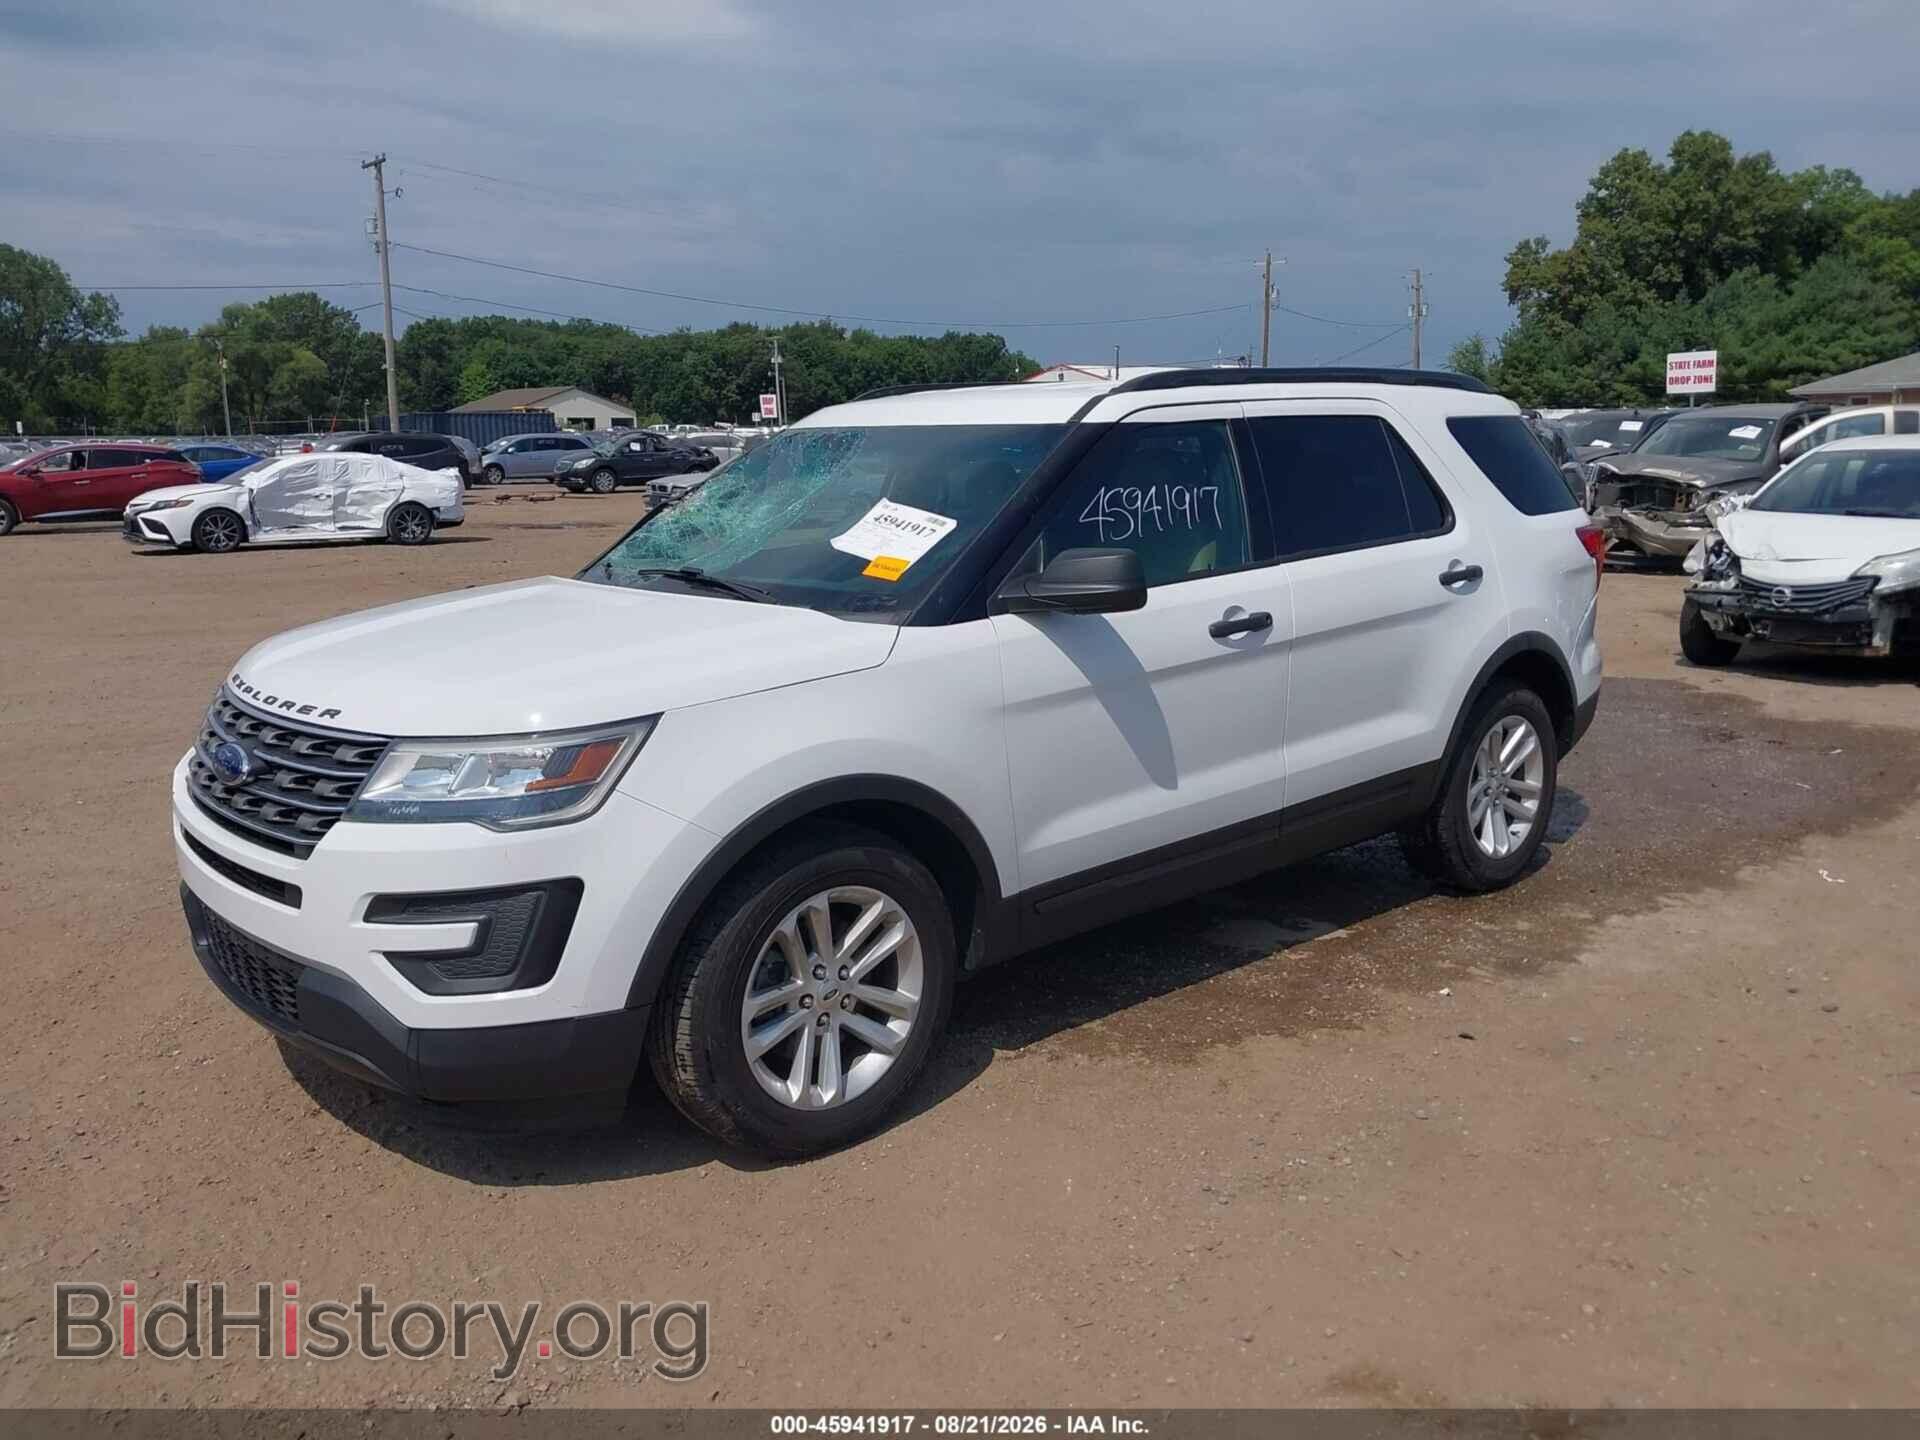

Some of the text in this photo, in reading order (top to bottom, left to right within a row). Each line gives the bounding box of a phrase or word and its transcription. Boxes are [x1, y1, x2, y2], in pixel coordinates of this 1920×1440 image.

[1668, 359, 1714, 370] STATE FARM
[1668, 374, 1713, 386] DROP ZONE
[873, 513, 937, 538] 45941917
[1079, 484, 1223, 543] 45941917
[232, 673, 343, 719] EXPLORER
